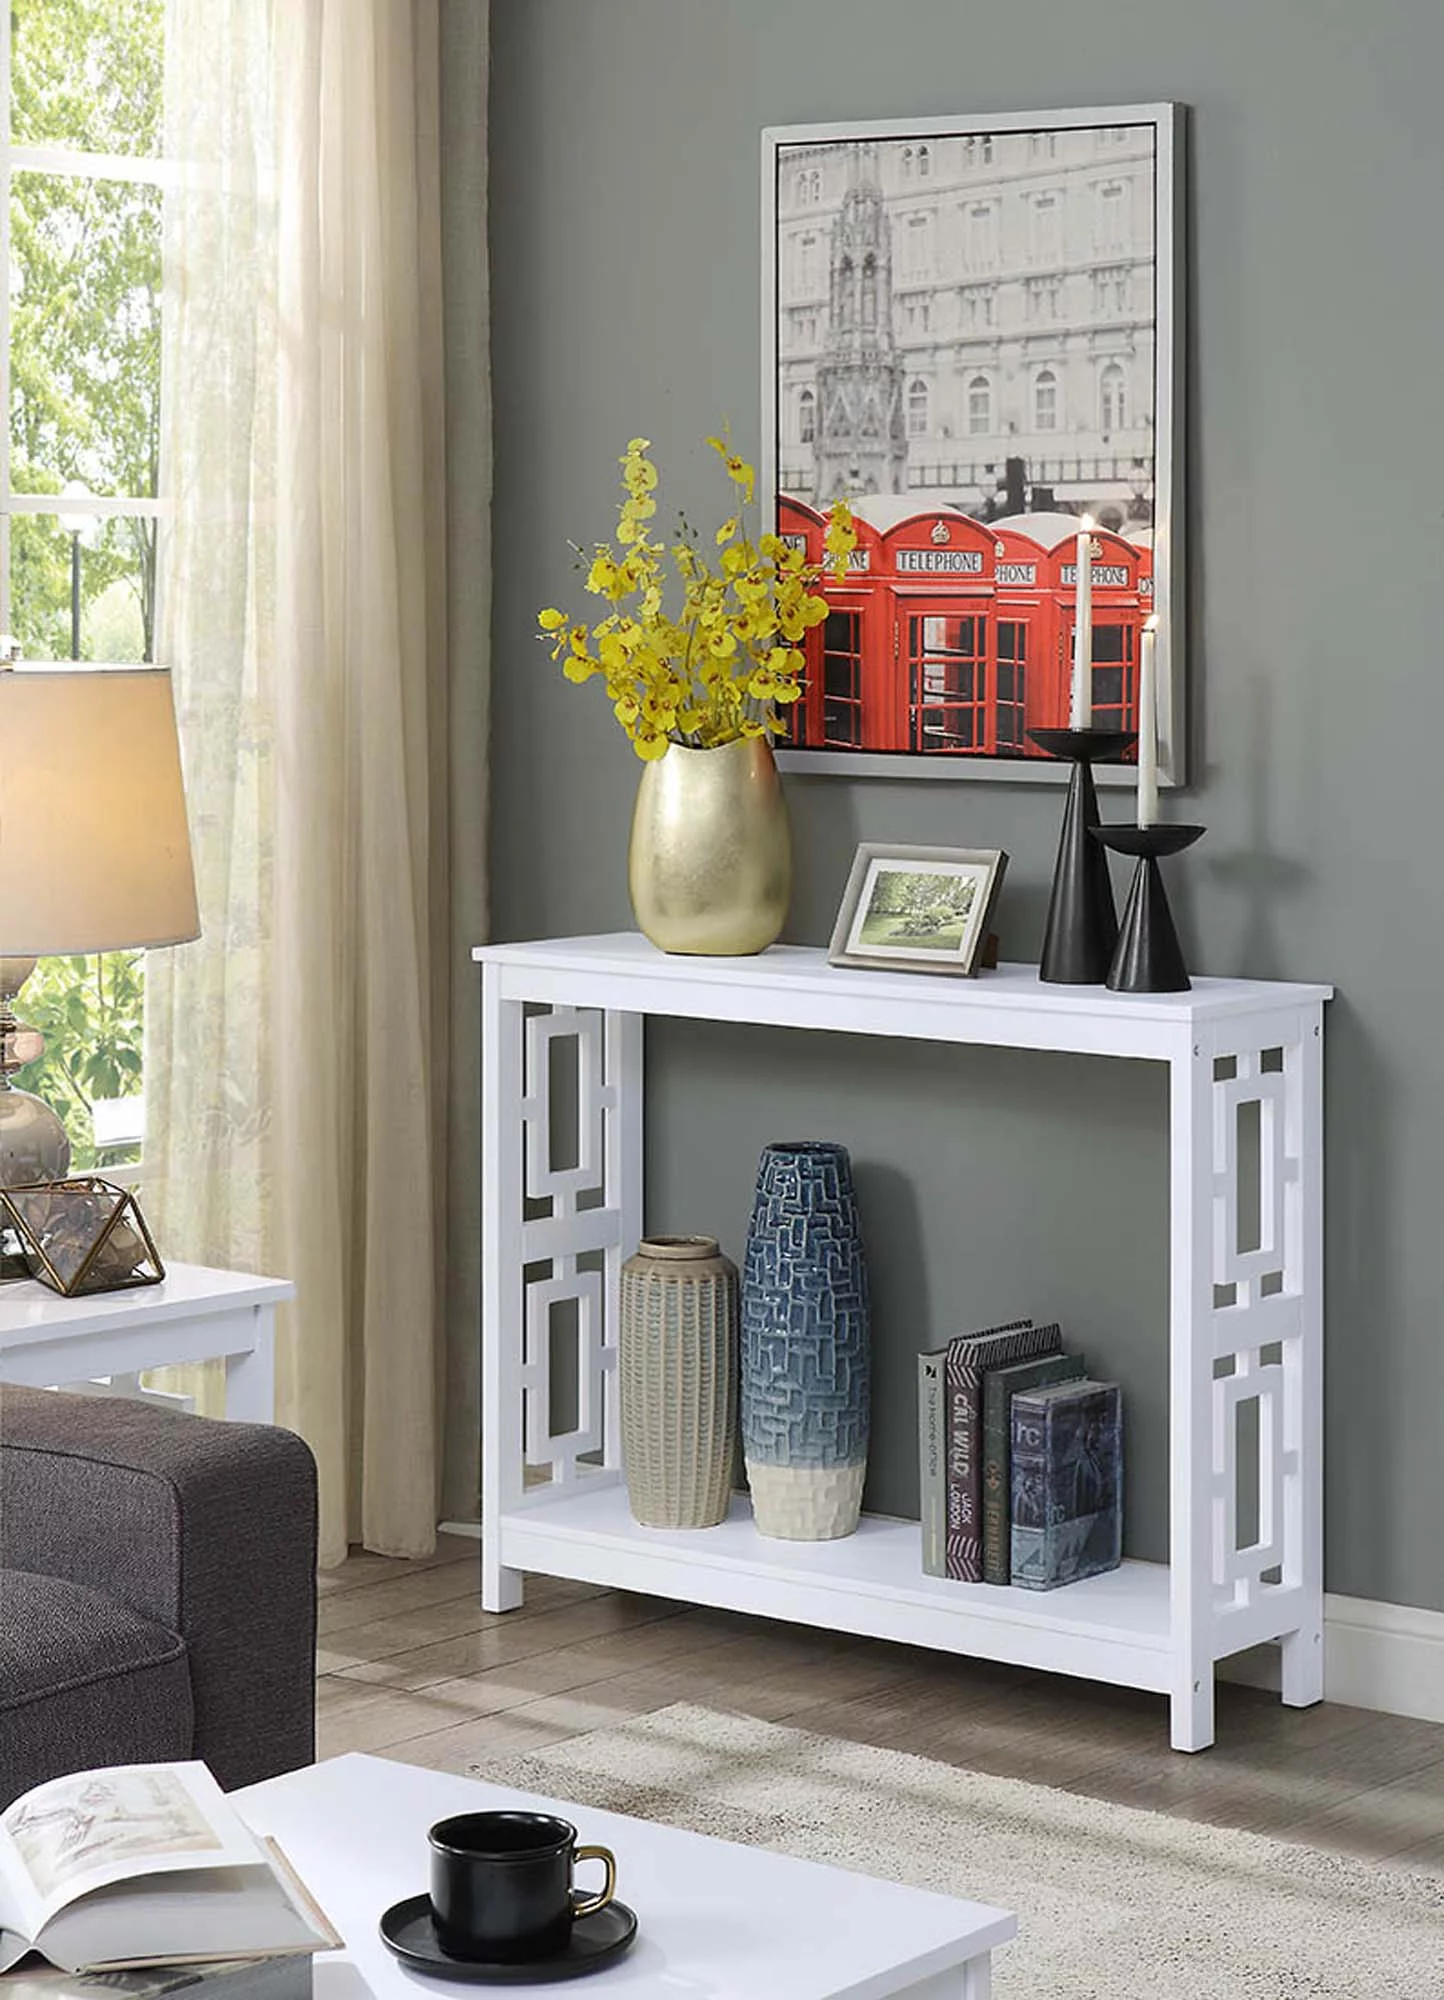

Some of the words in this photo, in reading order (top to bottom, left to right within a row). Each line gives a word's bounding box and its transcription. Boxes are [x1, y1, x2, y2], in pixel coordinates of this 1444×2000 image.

[900, 552, 977, 571] TELEPHONE
[1063, 566, 1125, 584] TEPHONE
[950, 1431, 970, 1478] WILD
[950, 1483, 961, 1530] LONDON
[961, 1492, 973, 1524] JACK
